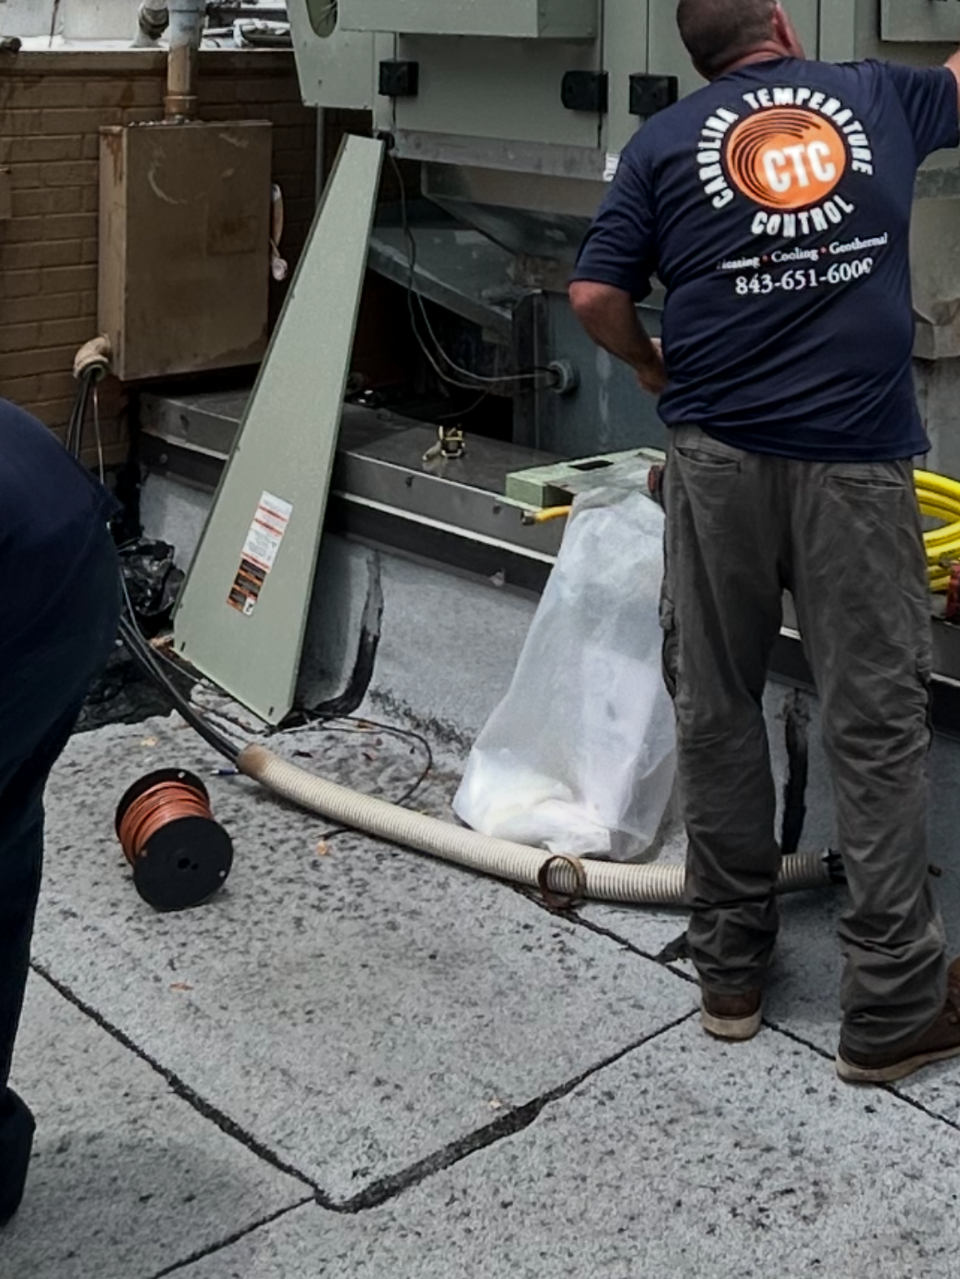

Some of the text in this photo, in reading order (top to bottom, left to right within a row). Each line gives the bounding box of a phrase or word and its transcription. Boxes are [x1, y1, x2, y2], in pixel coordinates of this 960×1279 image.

[696, 87, 874, 209] CAROLINA TEMPERATURE
[762, 140, 836, 193] CTC
[751, 194, 855, 237] CONTROL
[771, 247, 819, 263] Cooling
[828, 231, 889, 255] Geothermal
[735, 257, 874, 295] 843-651-6000
